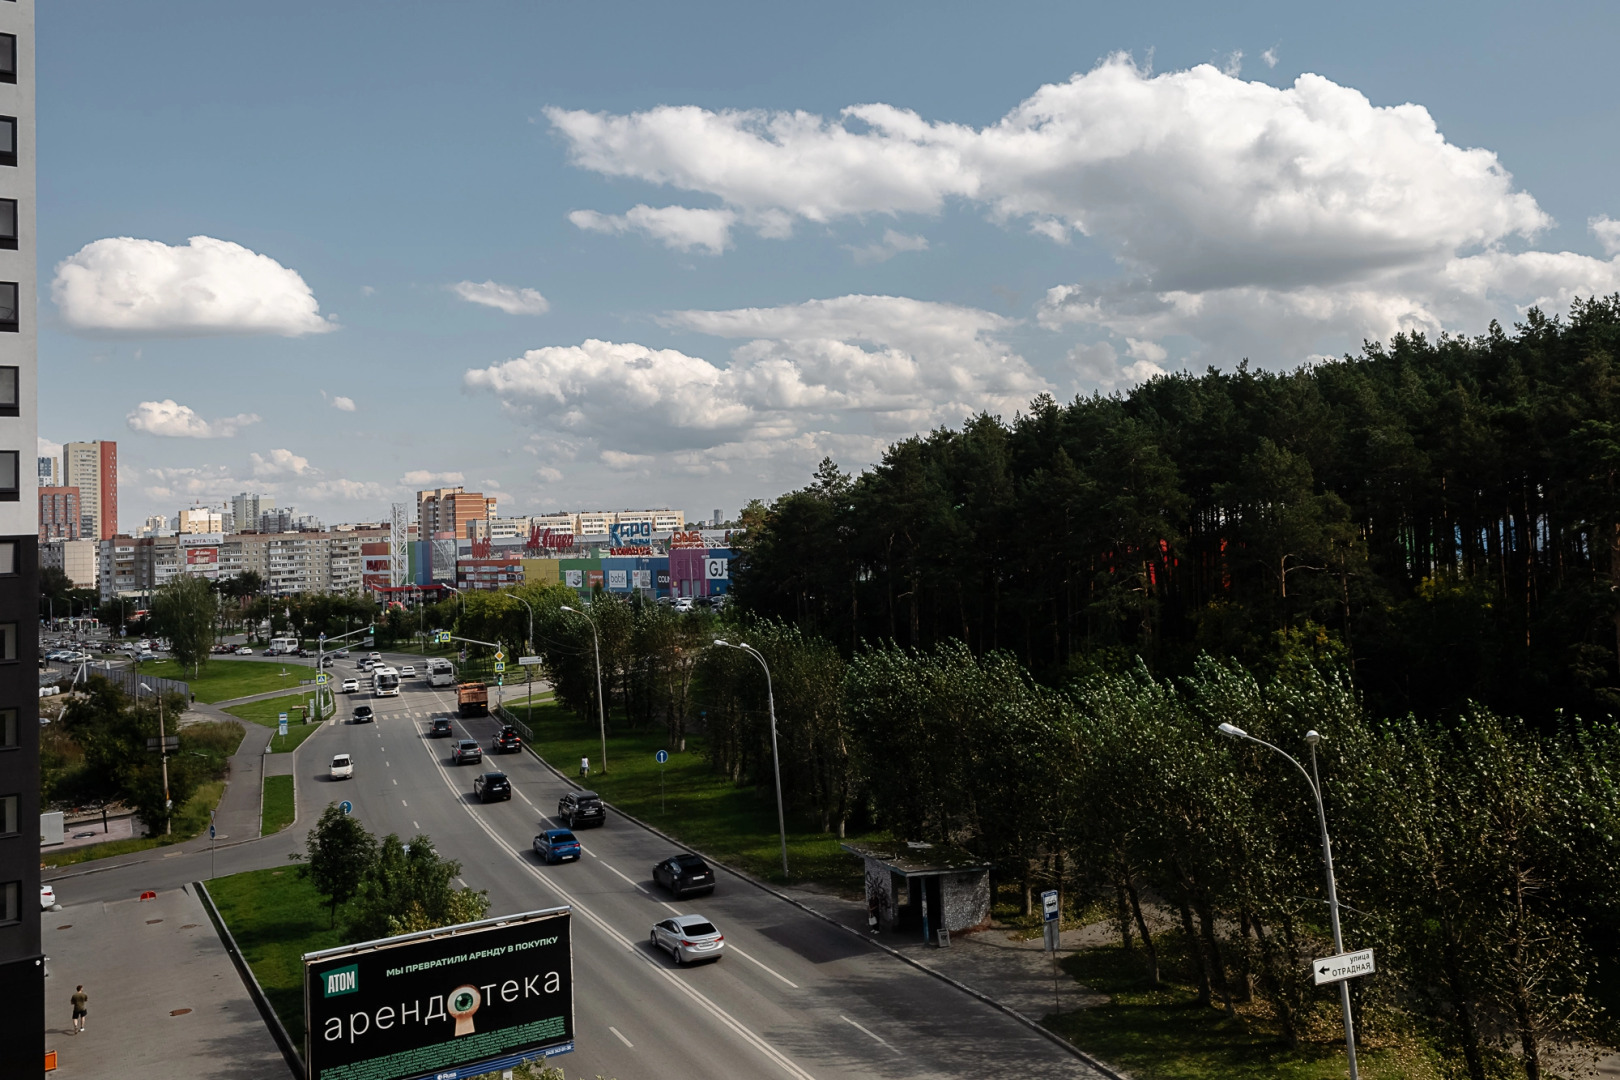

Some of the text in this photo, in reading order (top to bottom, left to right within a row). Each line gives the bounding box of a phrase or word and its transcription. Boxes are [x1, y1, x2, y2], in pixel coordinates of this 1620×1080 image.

[386, 936, 559, 977] МЫ ПРЕВРАТИЛИ АРЕНДУ В ПОКУПКУ
[1349, 953, 1370, 964] улица
[1332, 962, 1371, 977] ОТРАДНАЯ
[327, 970, 356, 994] АТОМ
